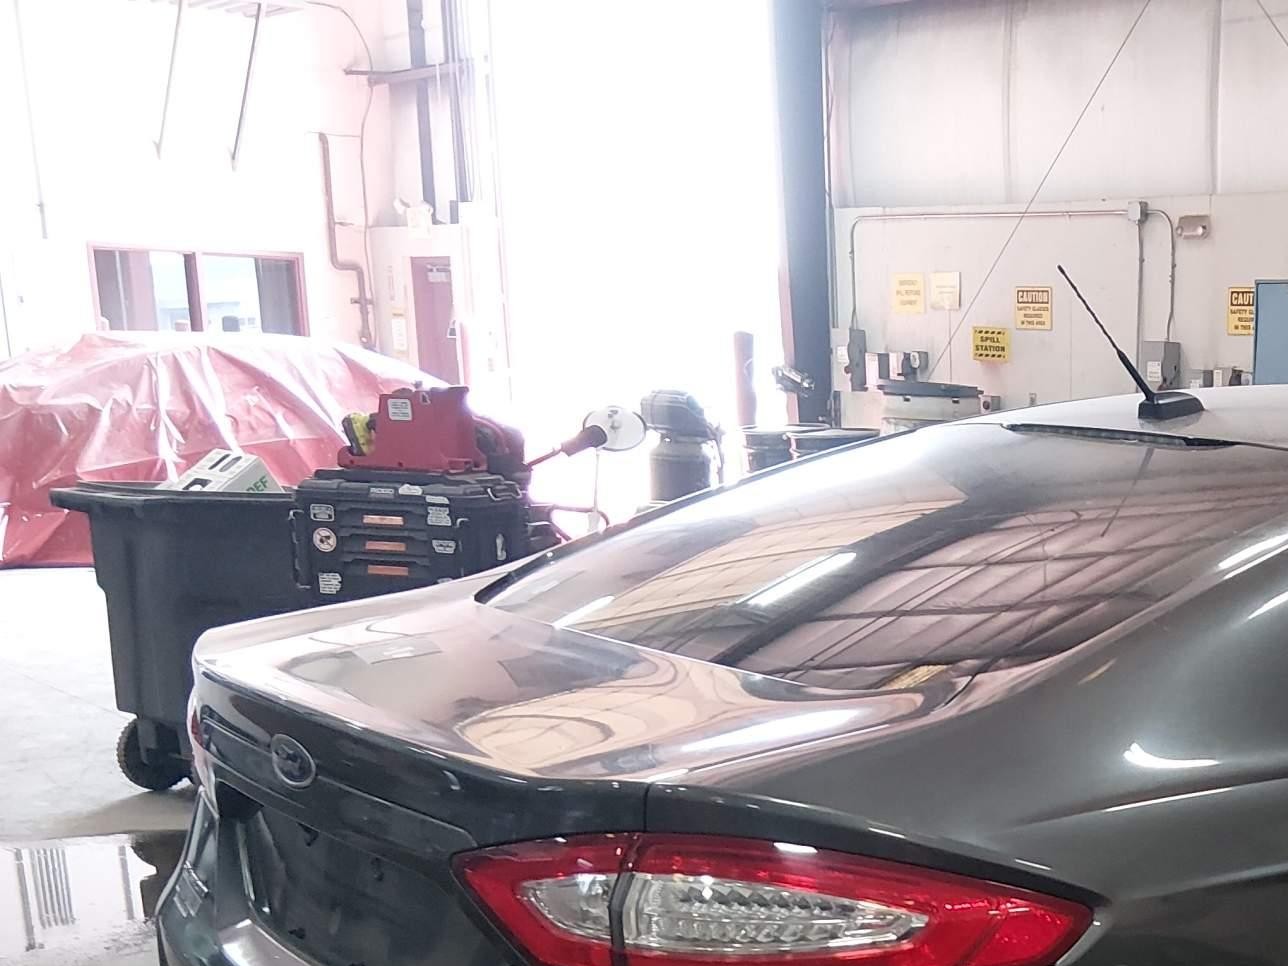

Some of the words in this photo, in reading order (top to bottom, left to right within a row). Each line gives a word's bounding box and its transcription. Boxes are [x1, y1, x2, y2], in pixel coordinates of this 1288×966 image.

[1018, 291, 1049, 303] CAUTION
[980, 336, 1001, 344] SPILL
[975, 345, 1006, 353] STATION
